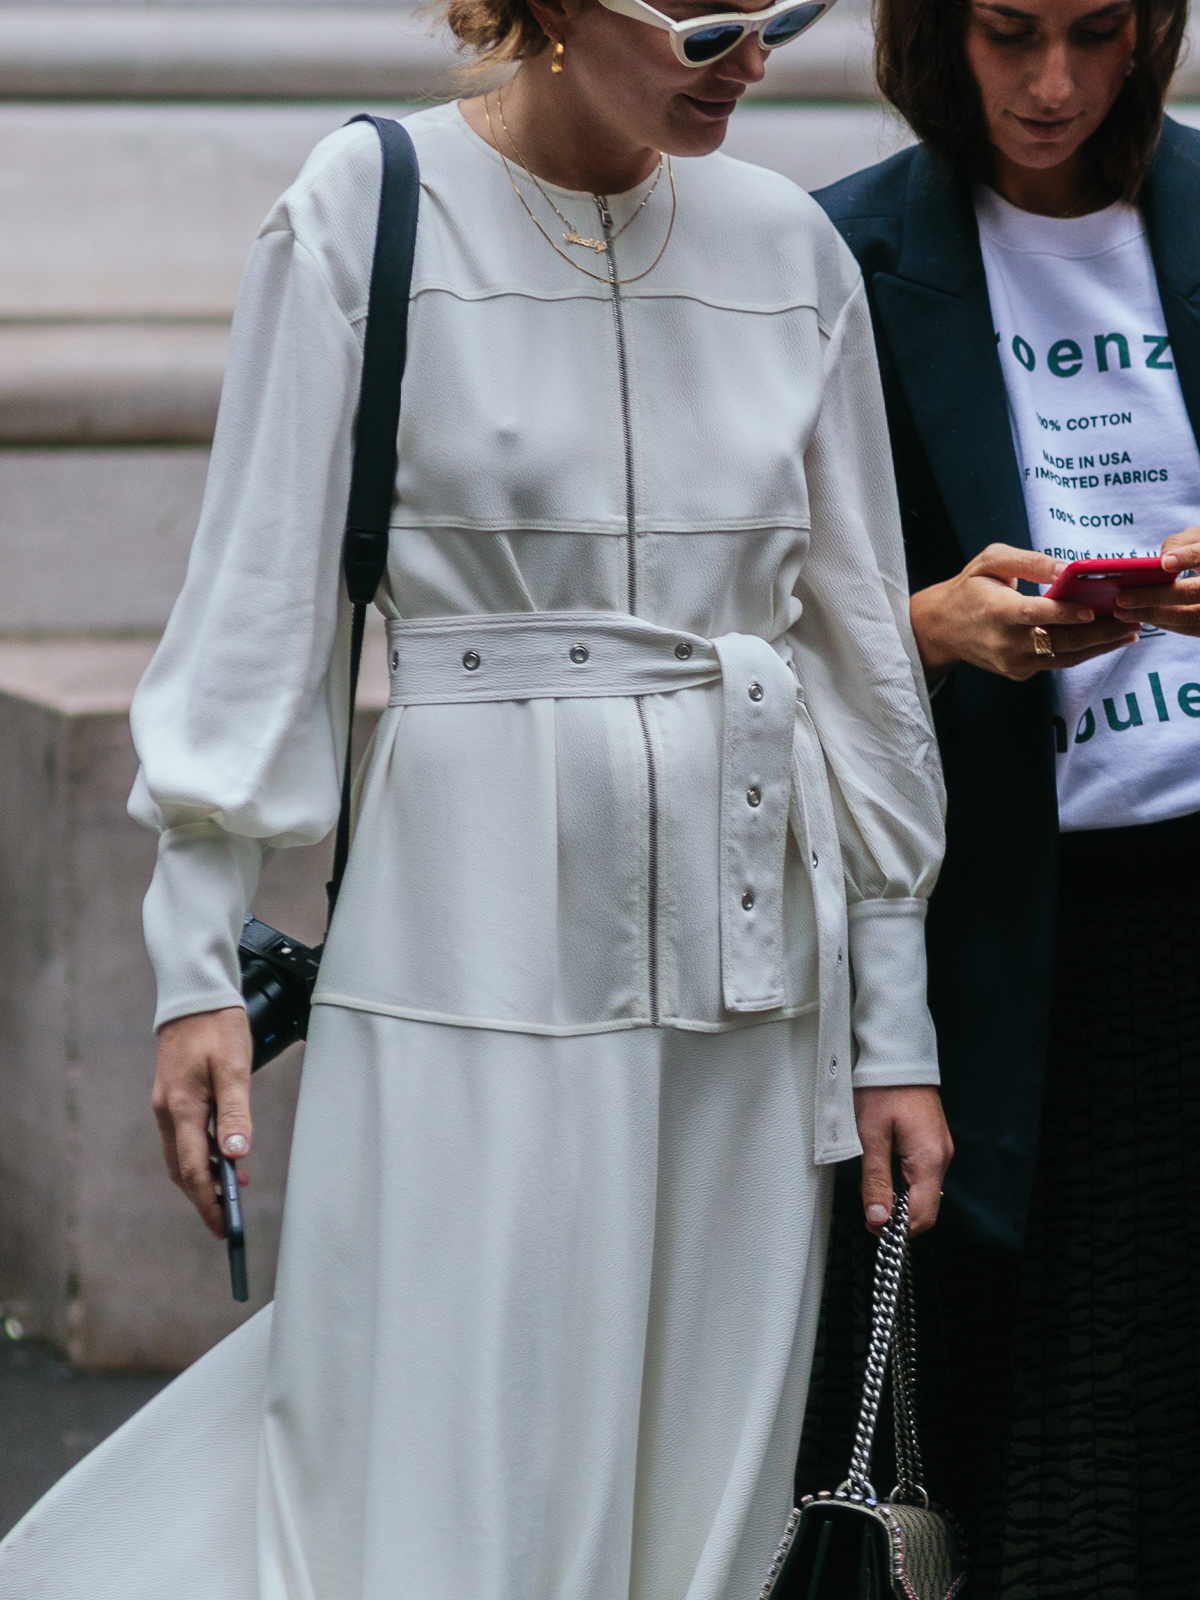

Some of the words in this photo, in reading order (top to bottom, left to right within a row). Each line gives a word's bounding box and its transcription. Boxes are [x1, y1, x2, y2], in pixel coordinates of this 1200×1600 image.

[994, 332, 1174, 378] oenz
[1066, 411, 1132, 431] COTTON
[1079, 456, 1095, 469] IN
[1099, 451, 1131, 466] USA
[1035, 466, 1099, 489] IMPORTED
[1104, 469, 1168, 487] FABRICS
[1049, 507, 1076, 525] 100%
[1080, 512, 1134, 527] COTON
[1037, 547, 1091, 561] BRIQUÉ
